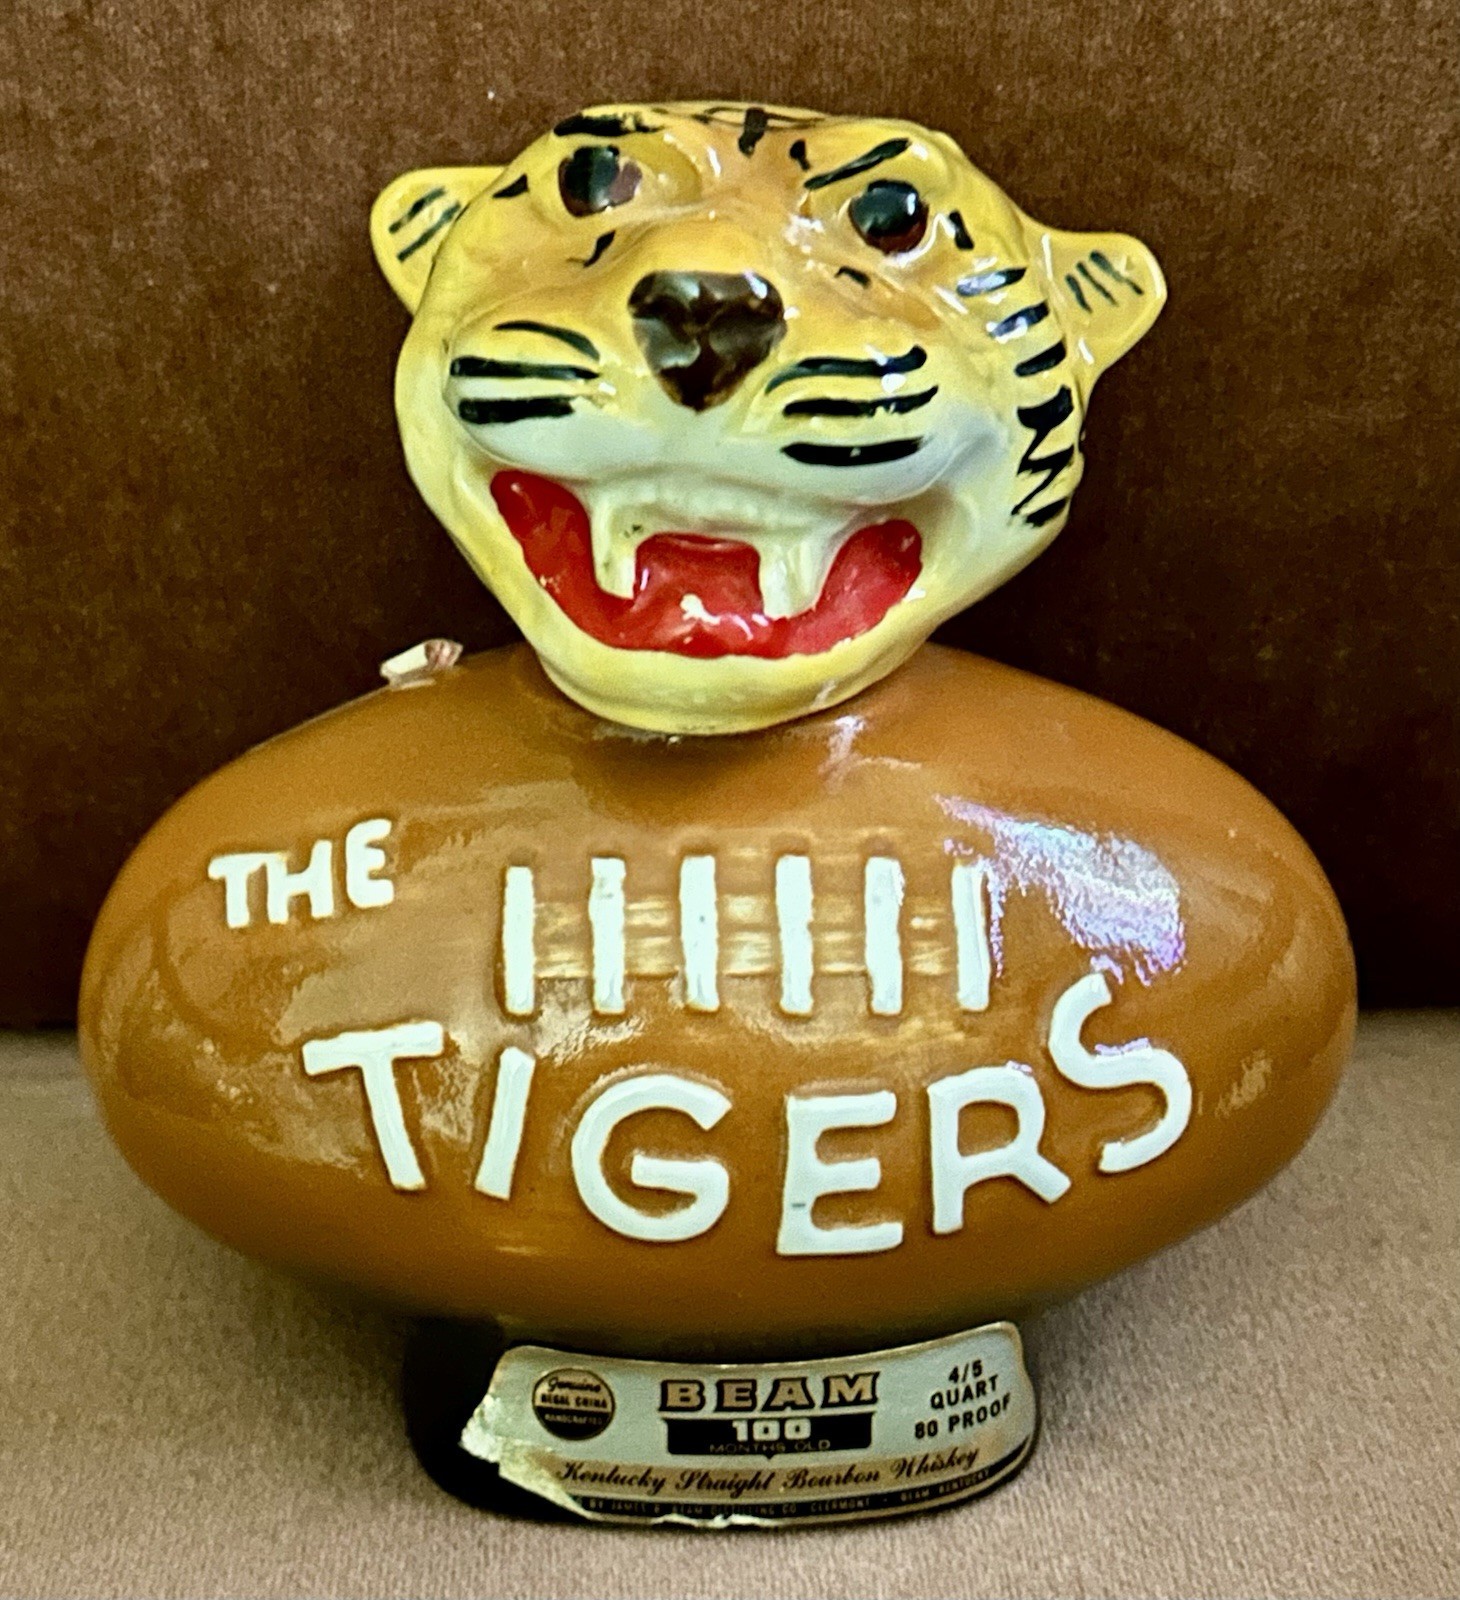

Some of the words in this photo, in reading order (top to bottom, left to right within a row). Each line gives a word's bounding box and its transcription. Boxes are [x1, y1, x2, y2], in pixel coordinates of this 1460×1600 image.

[208, 819, 395, 929] THE
[302, 972, 1192, 1256] TIGERS
[948, 1360, 984, 1384] 4/5
[575, 1396, 608, 1409] CHINA
[659, 1371, 881, 1413] BEAM
[930, 1374, 999, 1410] QUART
[732, 1418, 811, 1442] 100
[914, 1421, 939, 1439] 80
[947, 1392, 1011, 1433] PROOF
[710, 1442, 786, 1454] MONTHS
[794, 1439, 831, 1451] OLD
[556, 1462, 666, 1496] Kentucky
[675, 1470, 776, 1499] Straight
[782, 1465, 880, 1489] Bourbon
[891, 1446, 980, 1479] Whiskey
